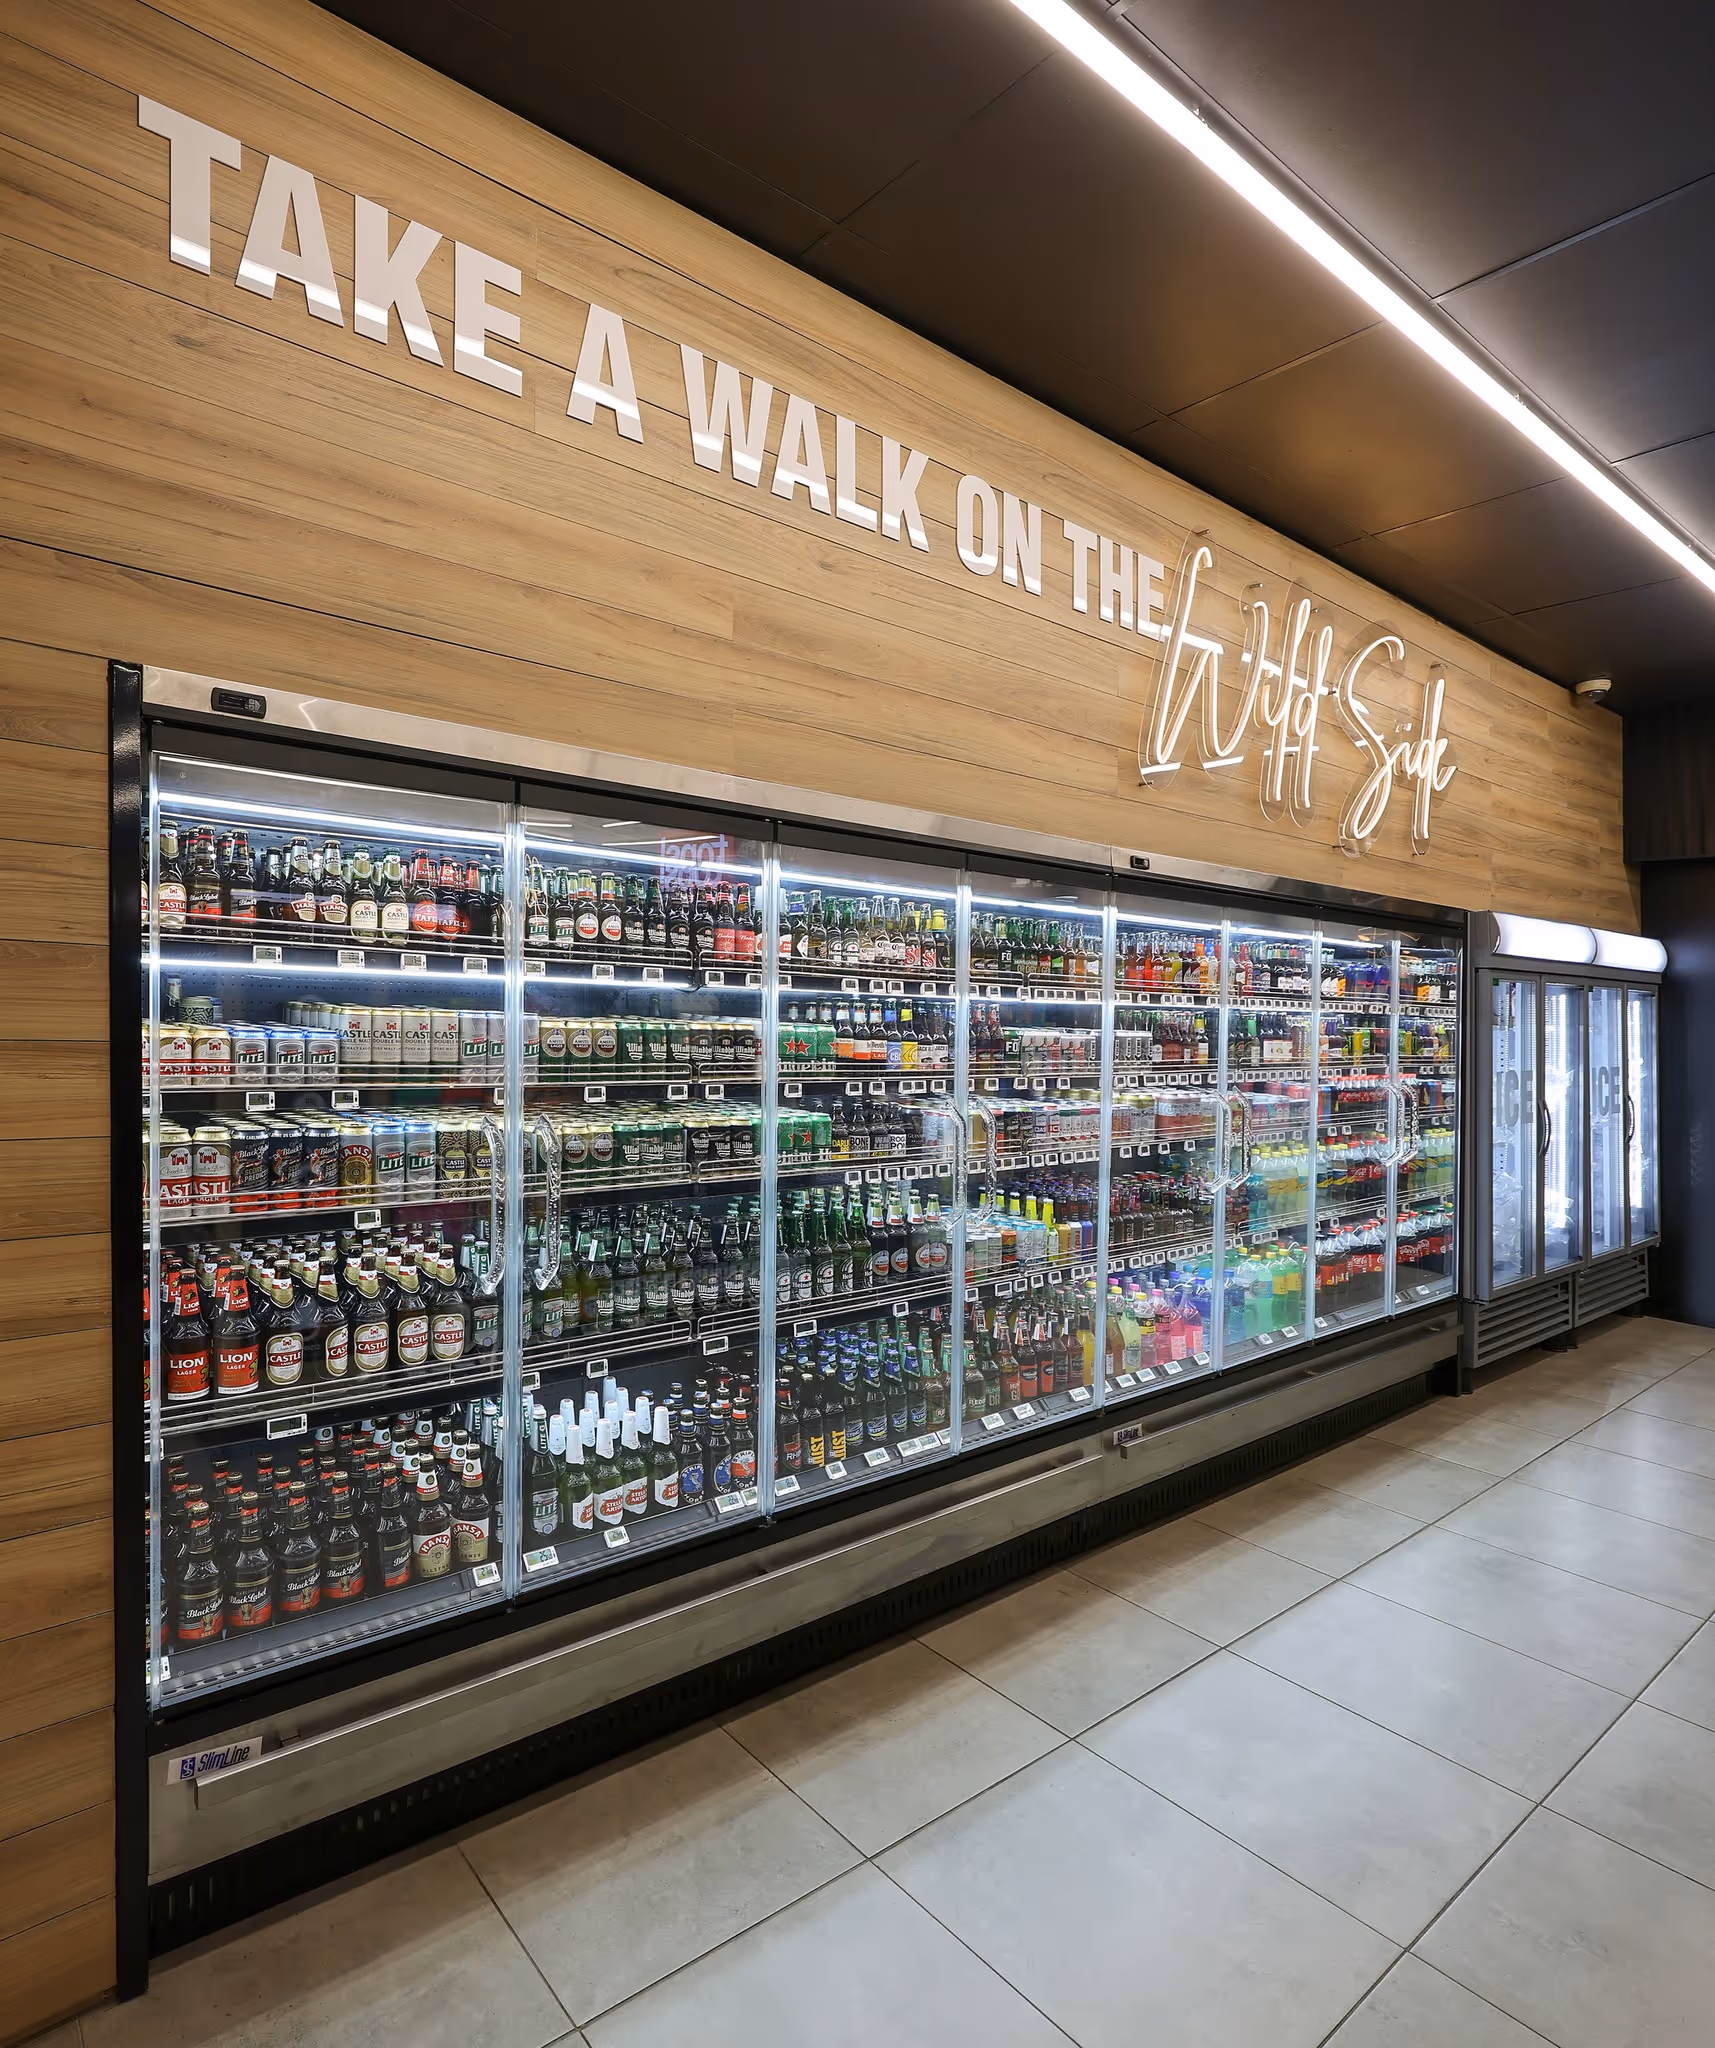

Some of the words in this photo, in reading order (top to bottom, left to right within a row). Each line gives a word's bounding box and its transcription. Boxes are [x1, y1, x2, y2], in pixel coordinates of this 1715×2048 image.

[137, 95, 523, 397] TAKE
[566, 303, 643, 442] A
[680, 343, 930, 553] WALK
[957, 474, 1042, 596] ON
[1063, 518, 1166, 642] THE
[530, 926, 548, 934] LITE
[240, 1053, 265, 1063] LITE
[281, 1053, 304, 1063] LITE
[312, 1053, 336, 1063] LITE
[1592, 1066, 1620, 1116] ICE
[1496, 1070, 1533, 1127] ICE
[381, 1157, 404, 1170] LITE
[411, 1156, 435, 1168] LITE
[476, 1318, 498, 1330] LITE
[402, 1334, 428, 1344] CASTLE
[435, 1332, 463, 1341] CASTLE
[358, 1340, 387, 1350] CASTLE
[170, 1357, 204, 1369] LION
[219, 1352, 253, 1363] LION
[270, 1352, 302, 1362] CASTLE
[535, 1503, 557, 1516] LITE
[453, 1524, 481, 1537] HANSA
[421, 1536, 450, 1552] HANSA
[287, 1580, 305, 1591] Black
[187, 1606, 210, 1618] Black
[198, 1746, 250, 1773] SlimLine
